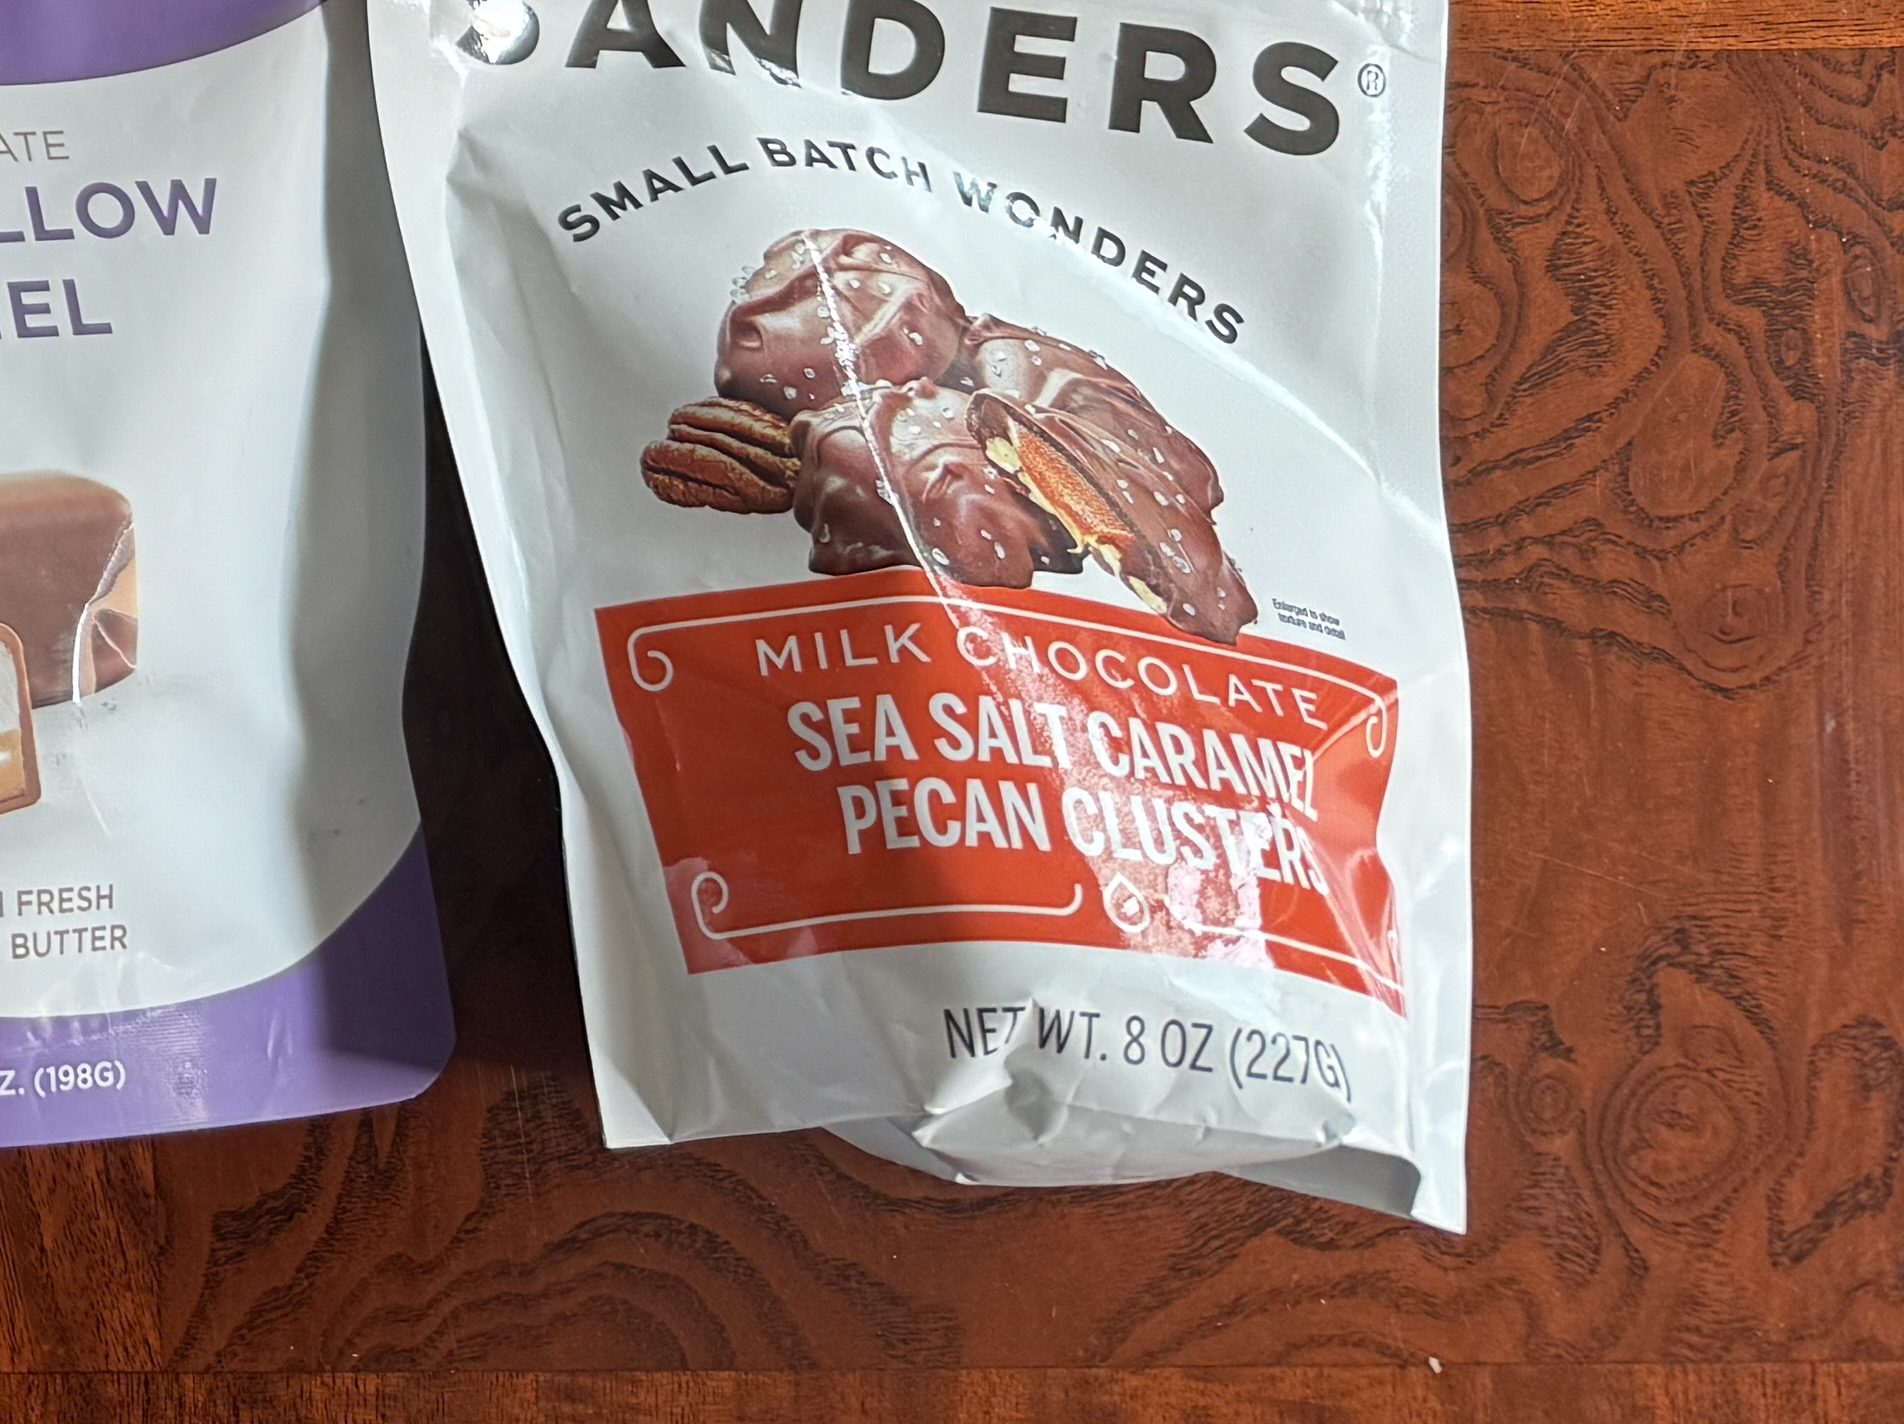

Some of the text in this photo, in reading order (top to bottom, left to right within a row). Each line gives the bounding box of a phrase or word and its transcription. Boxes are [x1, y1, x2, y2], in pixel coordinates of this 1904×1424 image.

[558, 137, 1245, 344] SMALL BATCH WONDERS
[757, 623, 1327, 731] MILK CHOCOLATE
[786, 693, 1319, 821] SEA SALT CARAMEL
[837, 779, 1329, 896] PECAN CLUSTERS
[11, 924, 128, 959] BUTTER
[16, 884, 114, 915] FRESH
[34, 1060, 126, 1096] (198G)
[944, 1006, 1352, 1103] NET WT. 8 OZ (227G)
